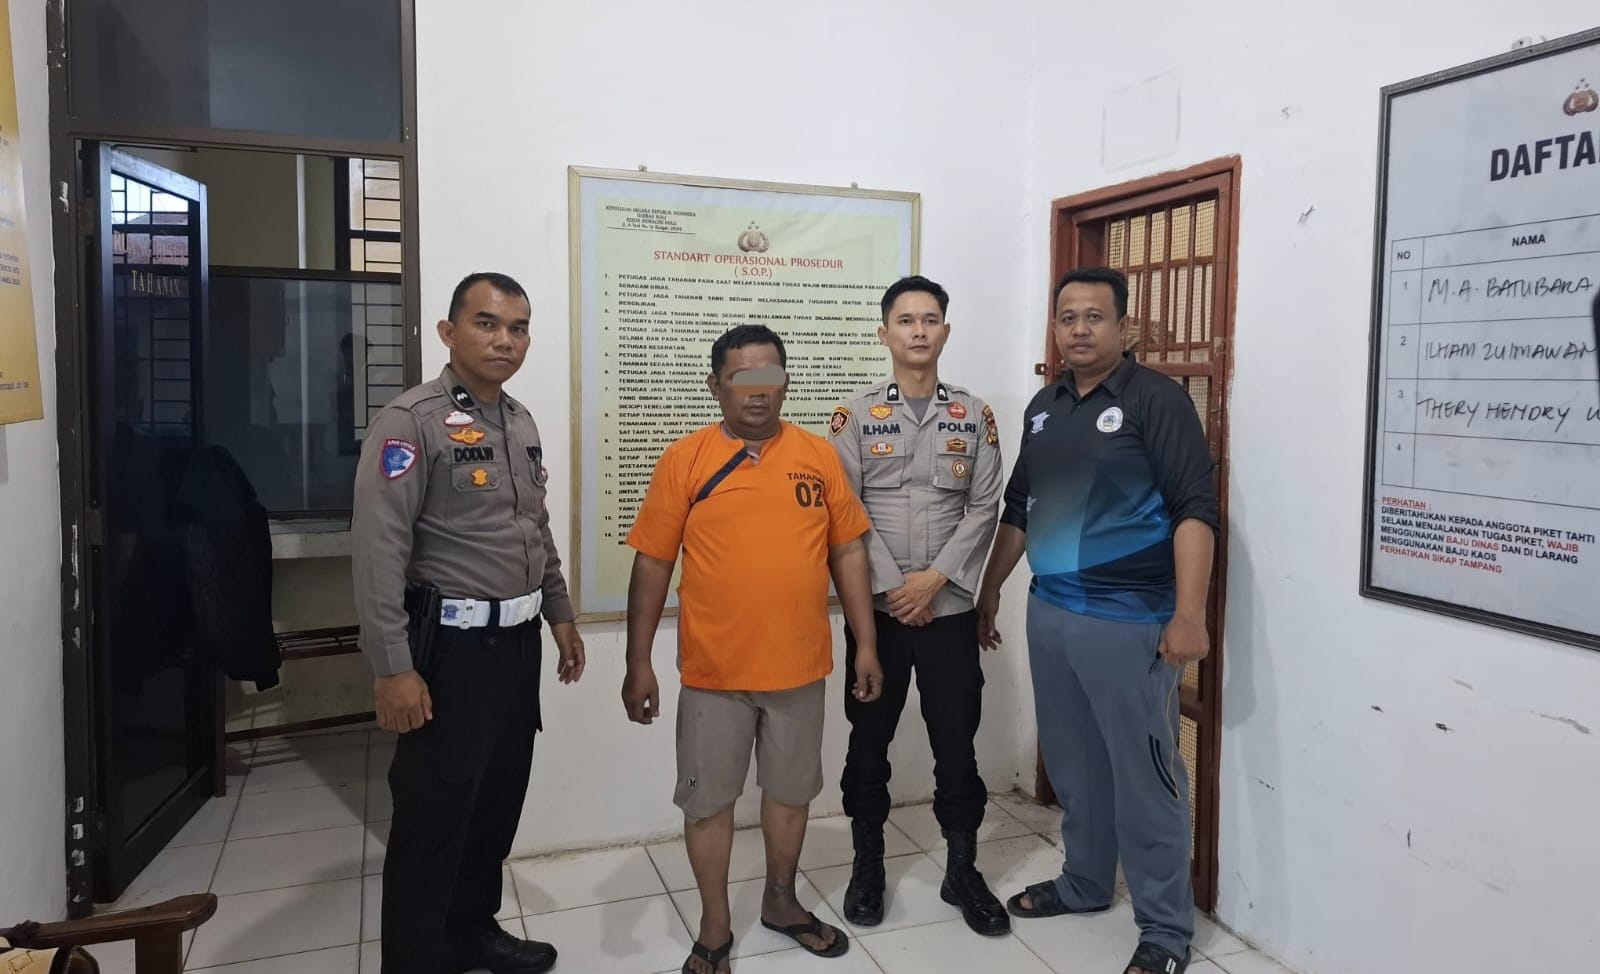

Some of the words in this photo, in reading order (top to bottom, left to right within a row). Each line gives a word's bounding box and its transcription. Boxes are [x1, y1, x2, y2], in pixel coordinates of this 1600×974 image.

[1490, 131, 1600, 182] DAFTA
[1512, 234, 1546, 247] NAMA
[654, 250, 710, 264] STANDART
[714, 254, 787, 266] OPERASIONAL
[791, 258, 844, 269] PROSEDUR
[1396, 251, 1411, 260] NO
[1403, 282, 1408, 290] 1
[1400, 336, 1407, 346] 2
[1398, 390, 1404, 399] 3
[1416, 398, 1480, 427] THERY
[863, 424, 901, 435] ILHAM
[938, 422, 976, 433] POLRI
[795, 482, 824, 508] 02
[1382, 496, 1426, 509] PERHATIAN
[1381, 516, 1413, 528] SELAMA
[1416, 521, 1479, 537] MENJALANKAN
[1482, 530, 1512, 543] TUGAS
[1515, 535, 1544, 548] PIKET,
[1547, 540, 1579, 552] WAJIB
[1382, 506, 1446, 522] DIBERITAHUKAN
[1448, 515, 1483, 527] KEPADA
[1485, 519, 1530, 534] ANGGOTA
[1533, 527, 1562, 539] PIKET
[1566, 531, 1595, 544] TAHTI
[1380, 535, 1443, 552] MENGGUNAKAN
[1446, 545, 1469, 557] BAJU
[1471, 550, 1497, 562] KAOS
[1381, 526, 1444, 542] MENGGUNAKAN
[1446, 536, 1469, 546] BAJU
[1471, 539, 1499, 551] DINAS
[1502, 544, 1521, 554] DAN
[1524, 547, 1533, 557] DI
[1535, 549, 1578, 564] LARANG
[1380, 545, 1430, 561] PERHATIKAN
[1432, 553, 1457, 565] SIKAP
[1459, 558, 1502, 574] TAMPANG
